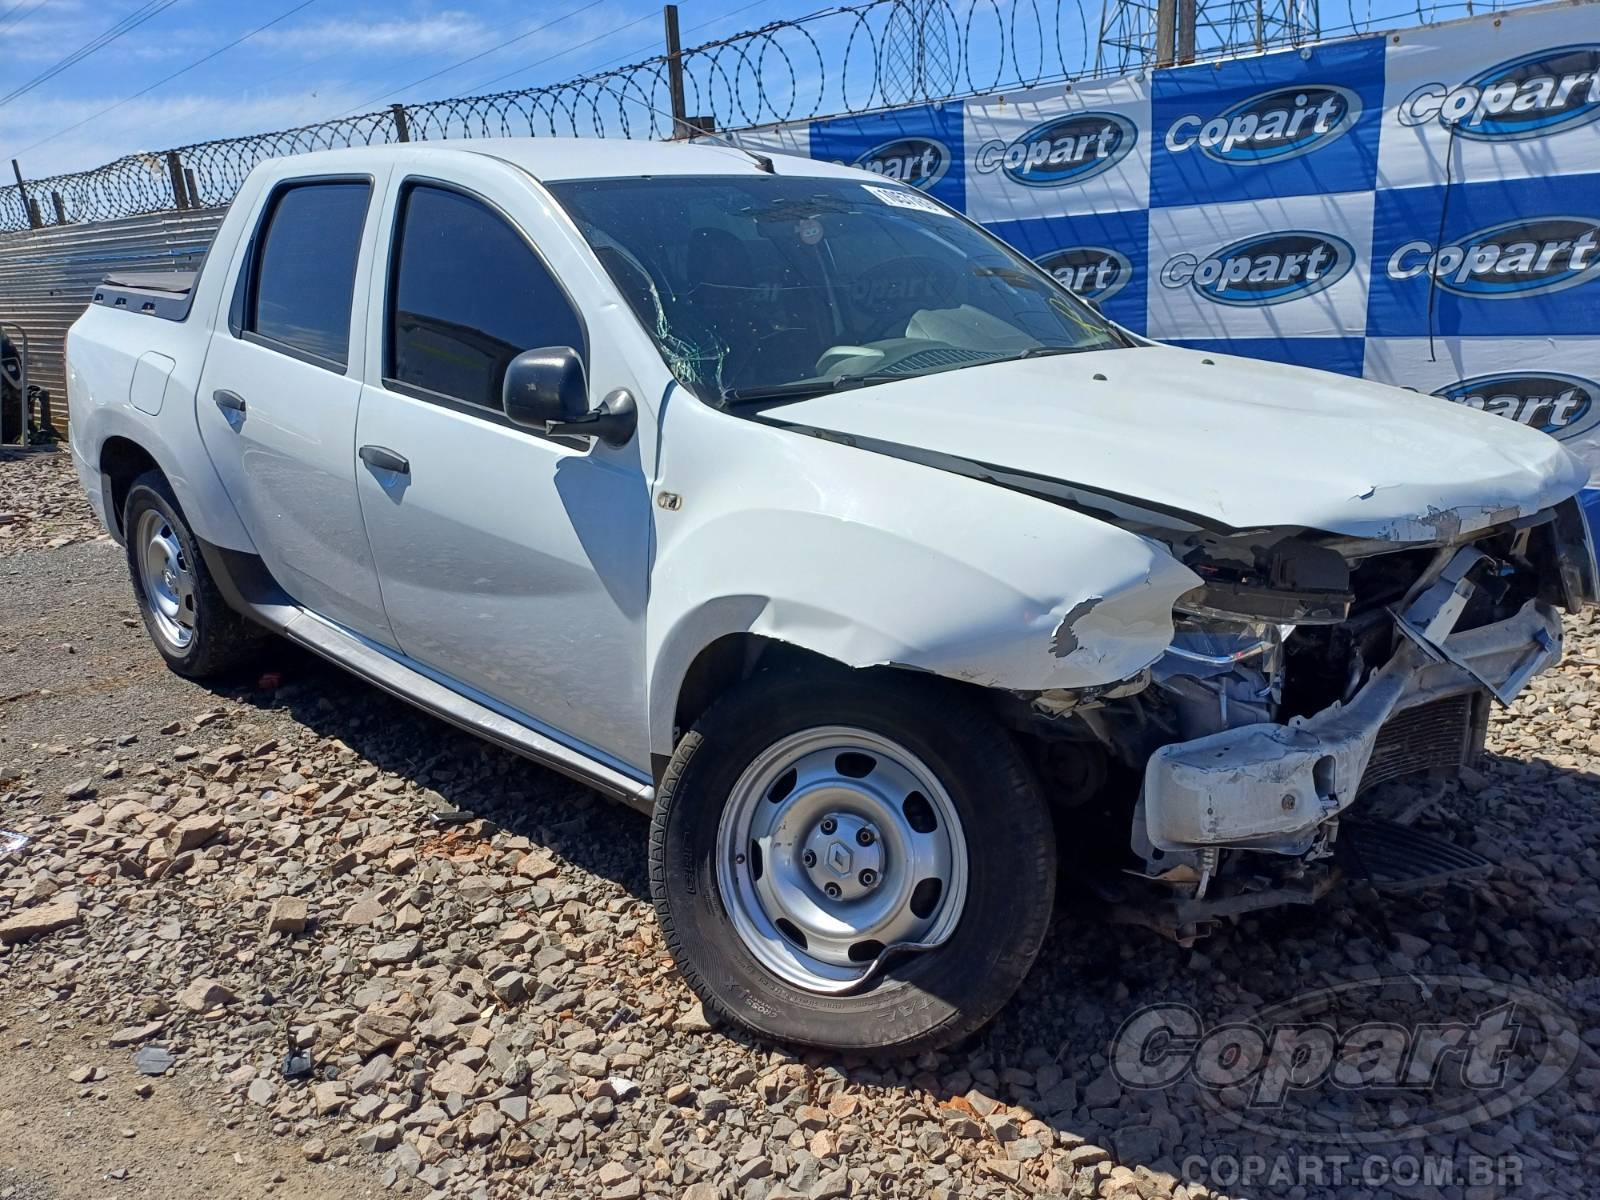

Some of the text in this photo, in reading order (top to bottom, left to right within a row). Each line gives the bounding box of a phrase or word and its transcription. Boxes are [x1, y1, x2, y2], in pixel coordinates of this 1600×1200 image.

[975, 126, 1115, 175] Copart
[1164, 97, 1338, 153] Copart
[1161, 239, 1329, 292] Copart
[1387, 231, 1597, 284] Copart
